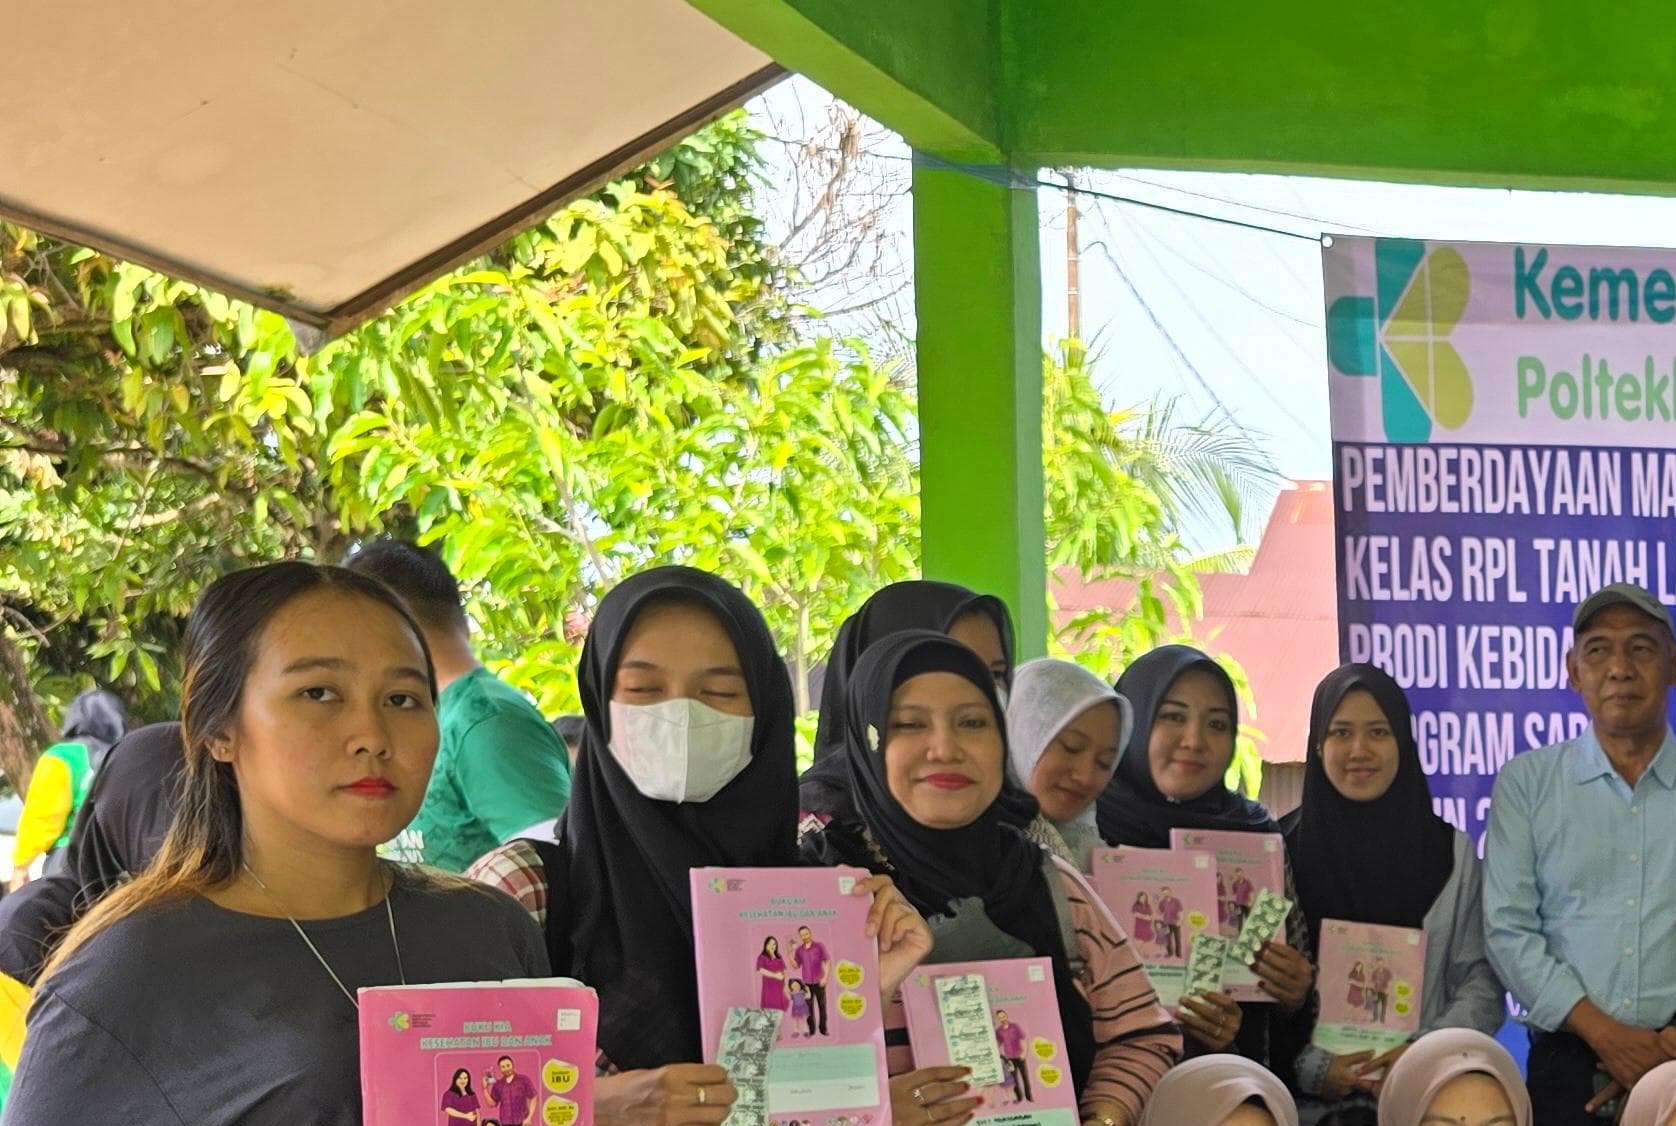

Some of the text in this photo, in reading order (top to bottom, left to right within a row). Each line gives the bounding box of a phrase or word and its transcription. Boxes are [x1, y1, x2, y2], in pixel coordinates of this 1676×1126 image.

[1341, 445, 1622, 516] PEMBERDAYAAN
[1345, 534, 1453, 603] KELAS
[1461, 536, 1528, 603] RPL
[1533, 538, 1649, 604] TANAH
[1349, 622, 1575, 690] PRODI KEBIDA
[1411, 709, 1516, 776] GRAM
